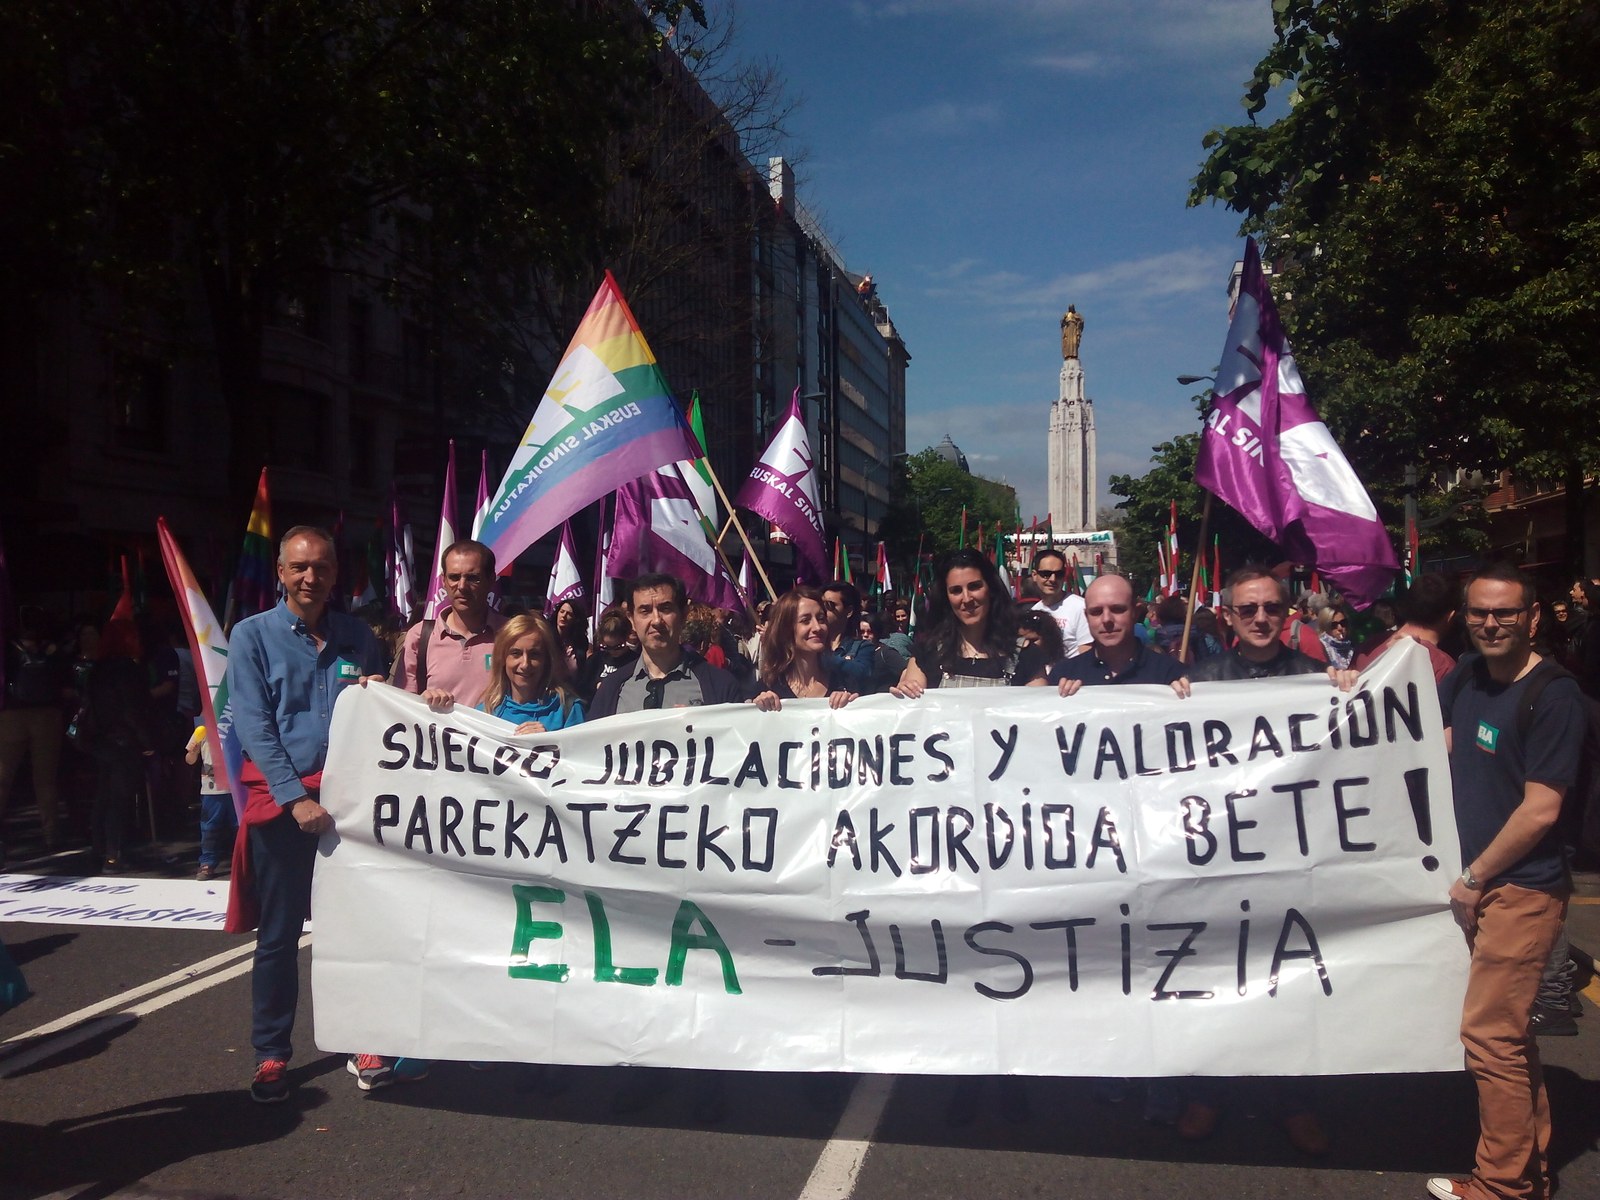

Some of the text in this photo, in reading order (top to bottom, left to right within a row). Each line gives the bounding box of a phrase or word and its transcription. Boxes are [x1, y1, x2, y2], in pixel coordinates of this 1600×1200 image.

[749, 466, 820, 532] EUSKAL SIND
[376, 722, 567, 788] SUELDO,
[581, 724, 956, 792] JUBILACIONES
[988, 724, 1019, 782] Y
[372, 793, 779, 875] PAREKATZEKO
